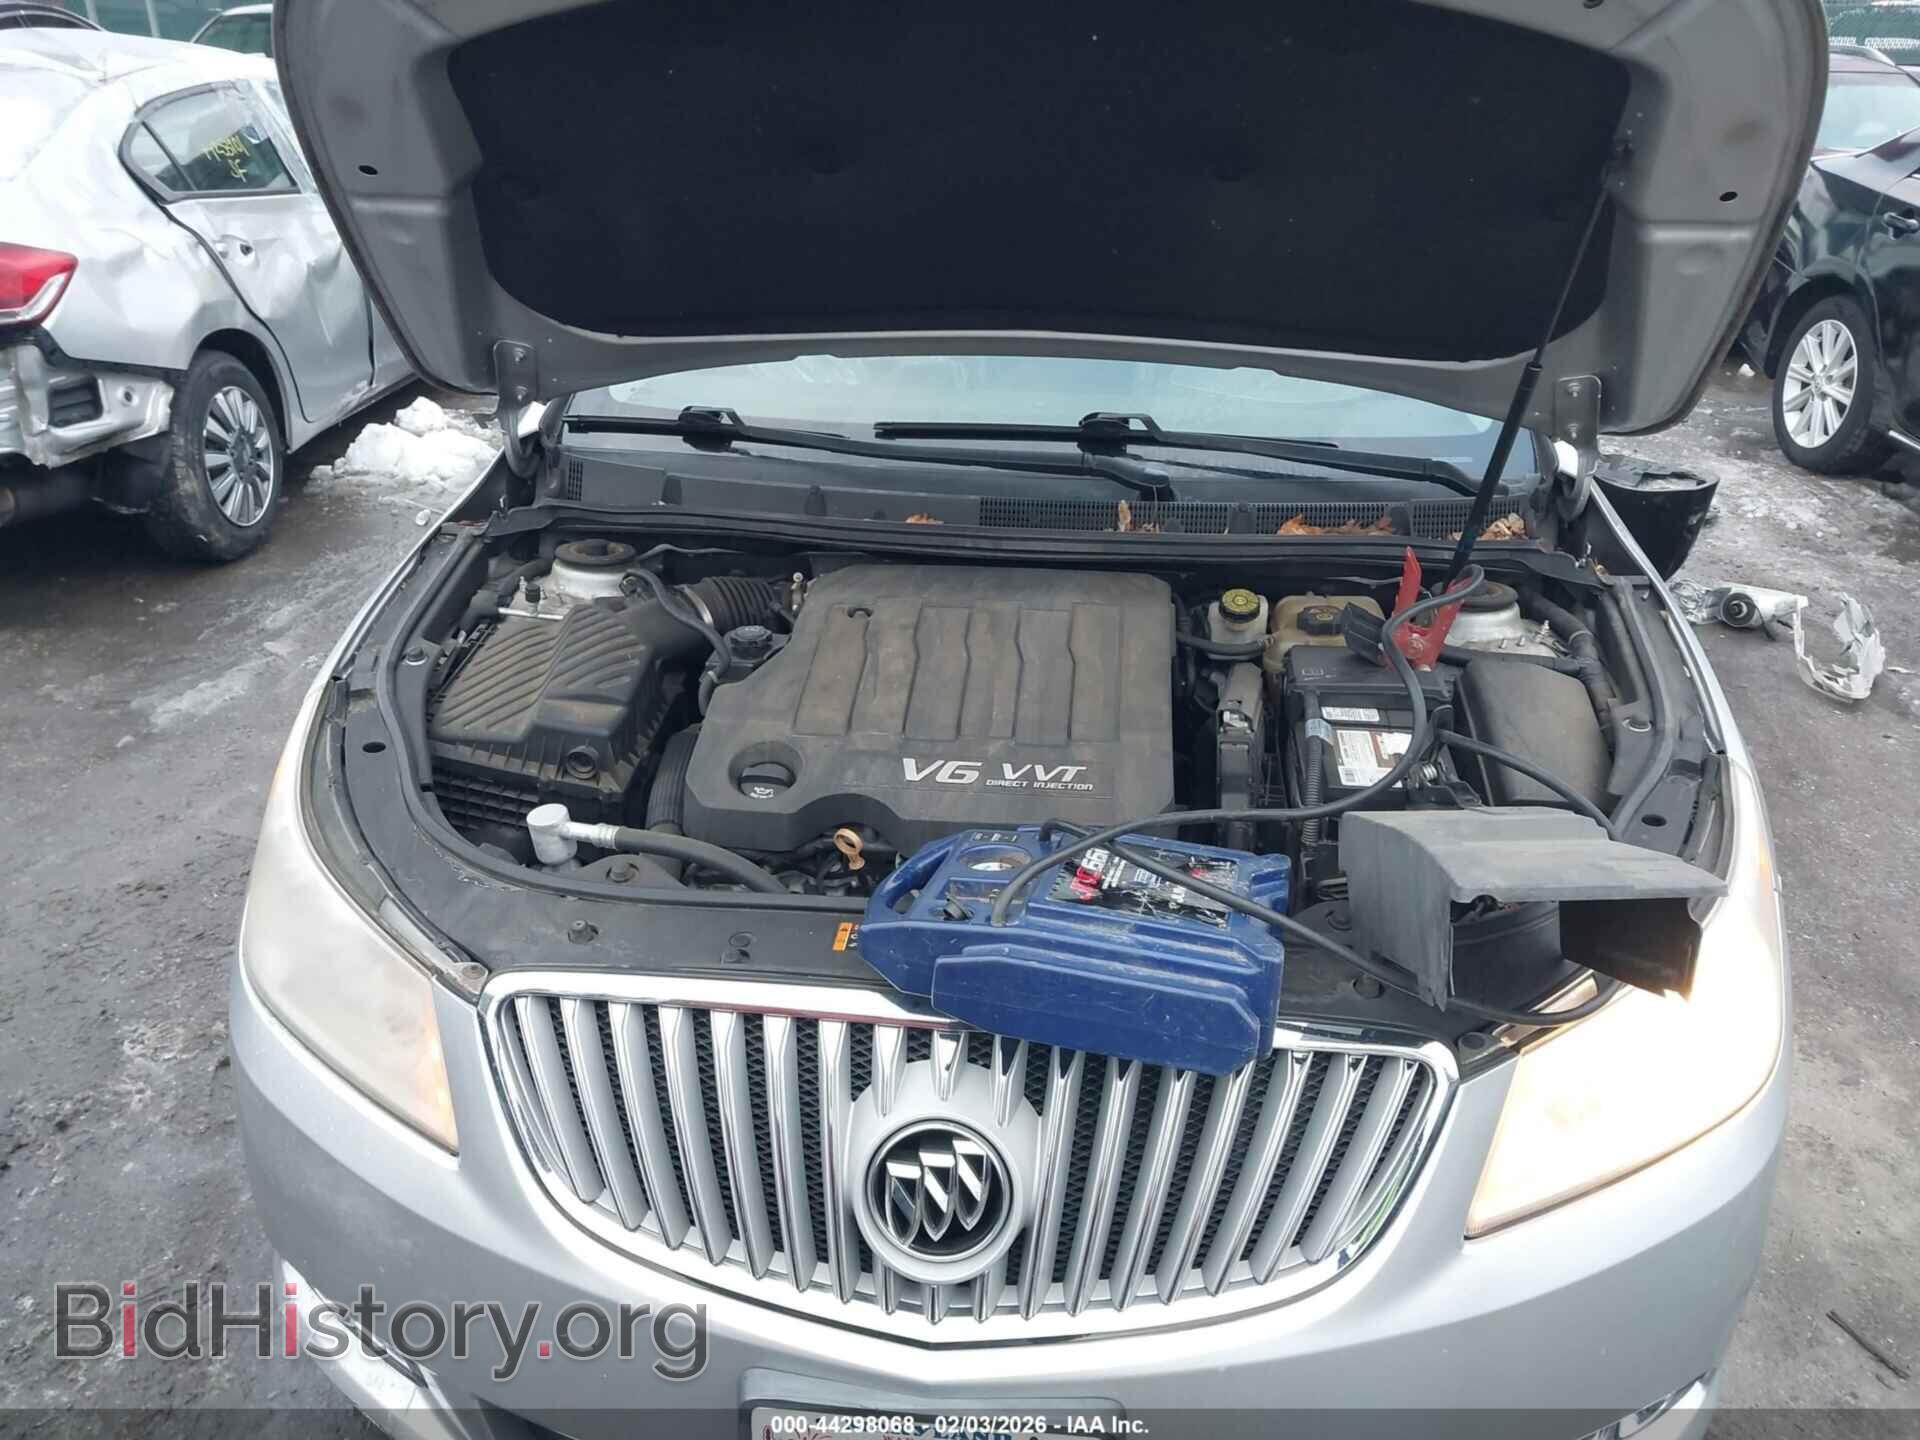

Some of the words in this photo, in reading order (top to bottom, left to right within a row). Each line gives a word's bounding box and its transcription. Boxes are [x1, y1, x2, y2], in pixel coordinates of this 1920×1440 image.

[902, 757, 983, 784] V6
[1002, 763, 1087, 782] VVT
[985, 779, 1028, 788] DIRECT
[1033, 781, 1094, 791] INJECTION
